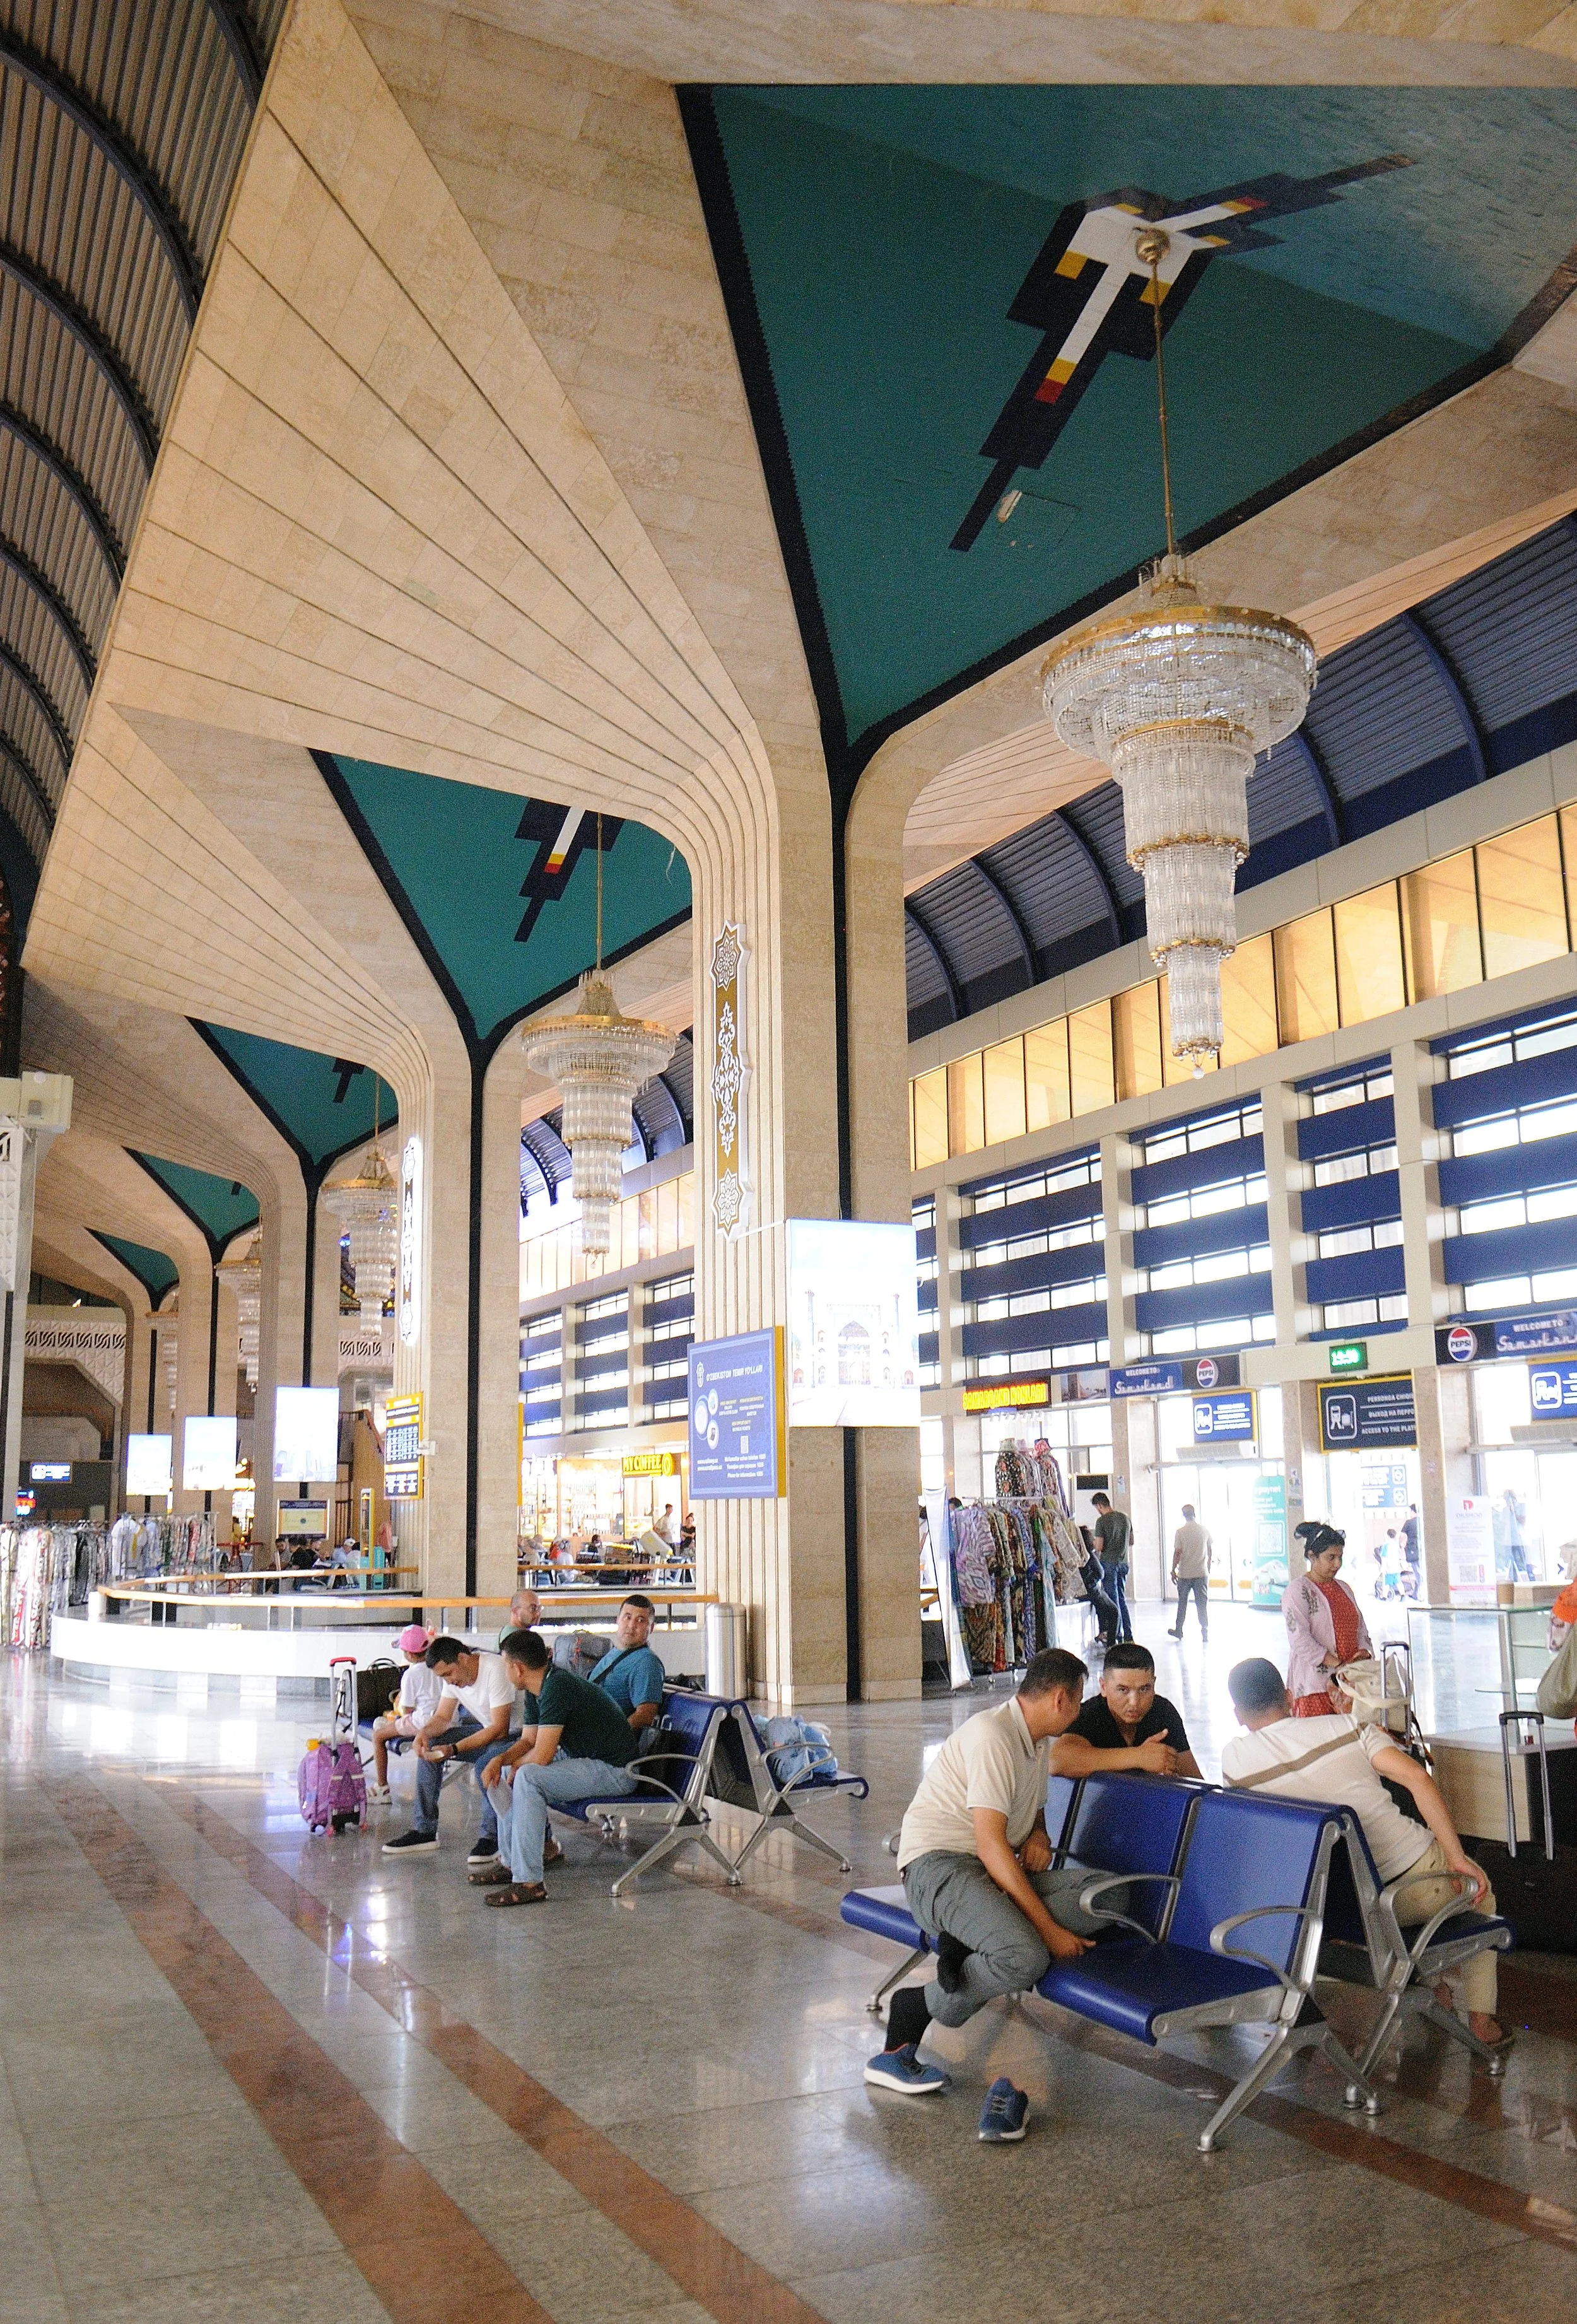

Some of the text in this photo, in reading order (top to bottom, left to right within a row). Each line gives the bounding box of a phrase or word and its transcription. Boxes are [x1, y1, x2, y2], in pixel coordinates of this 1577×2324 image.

[1513, 1320, 1554, 1332] WELCOME
[732, 1367, 744, 1377] TEMIR
[1125, 1367, 1149, 1376] WELCOME
[1199, 1369, 1214, 1377] PEPSI
[1114, 1375, 1175, 1395] Samarkand
[962, 1387, 1010, 1411] SAMARQAND
[1368, 1410, 1388, 1418] ВЫХОД
[623, 1453, 662, 1472] MY COFFEE
